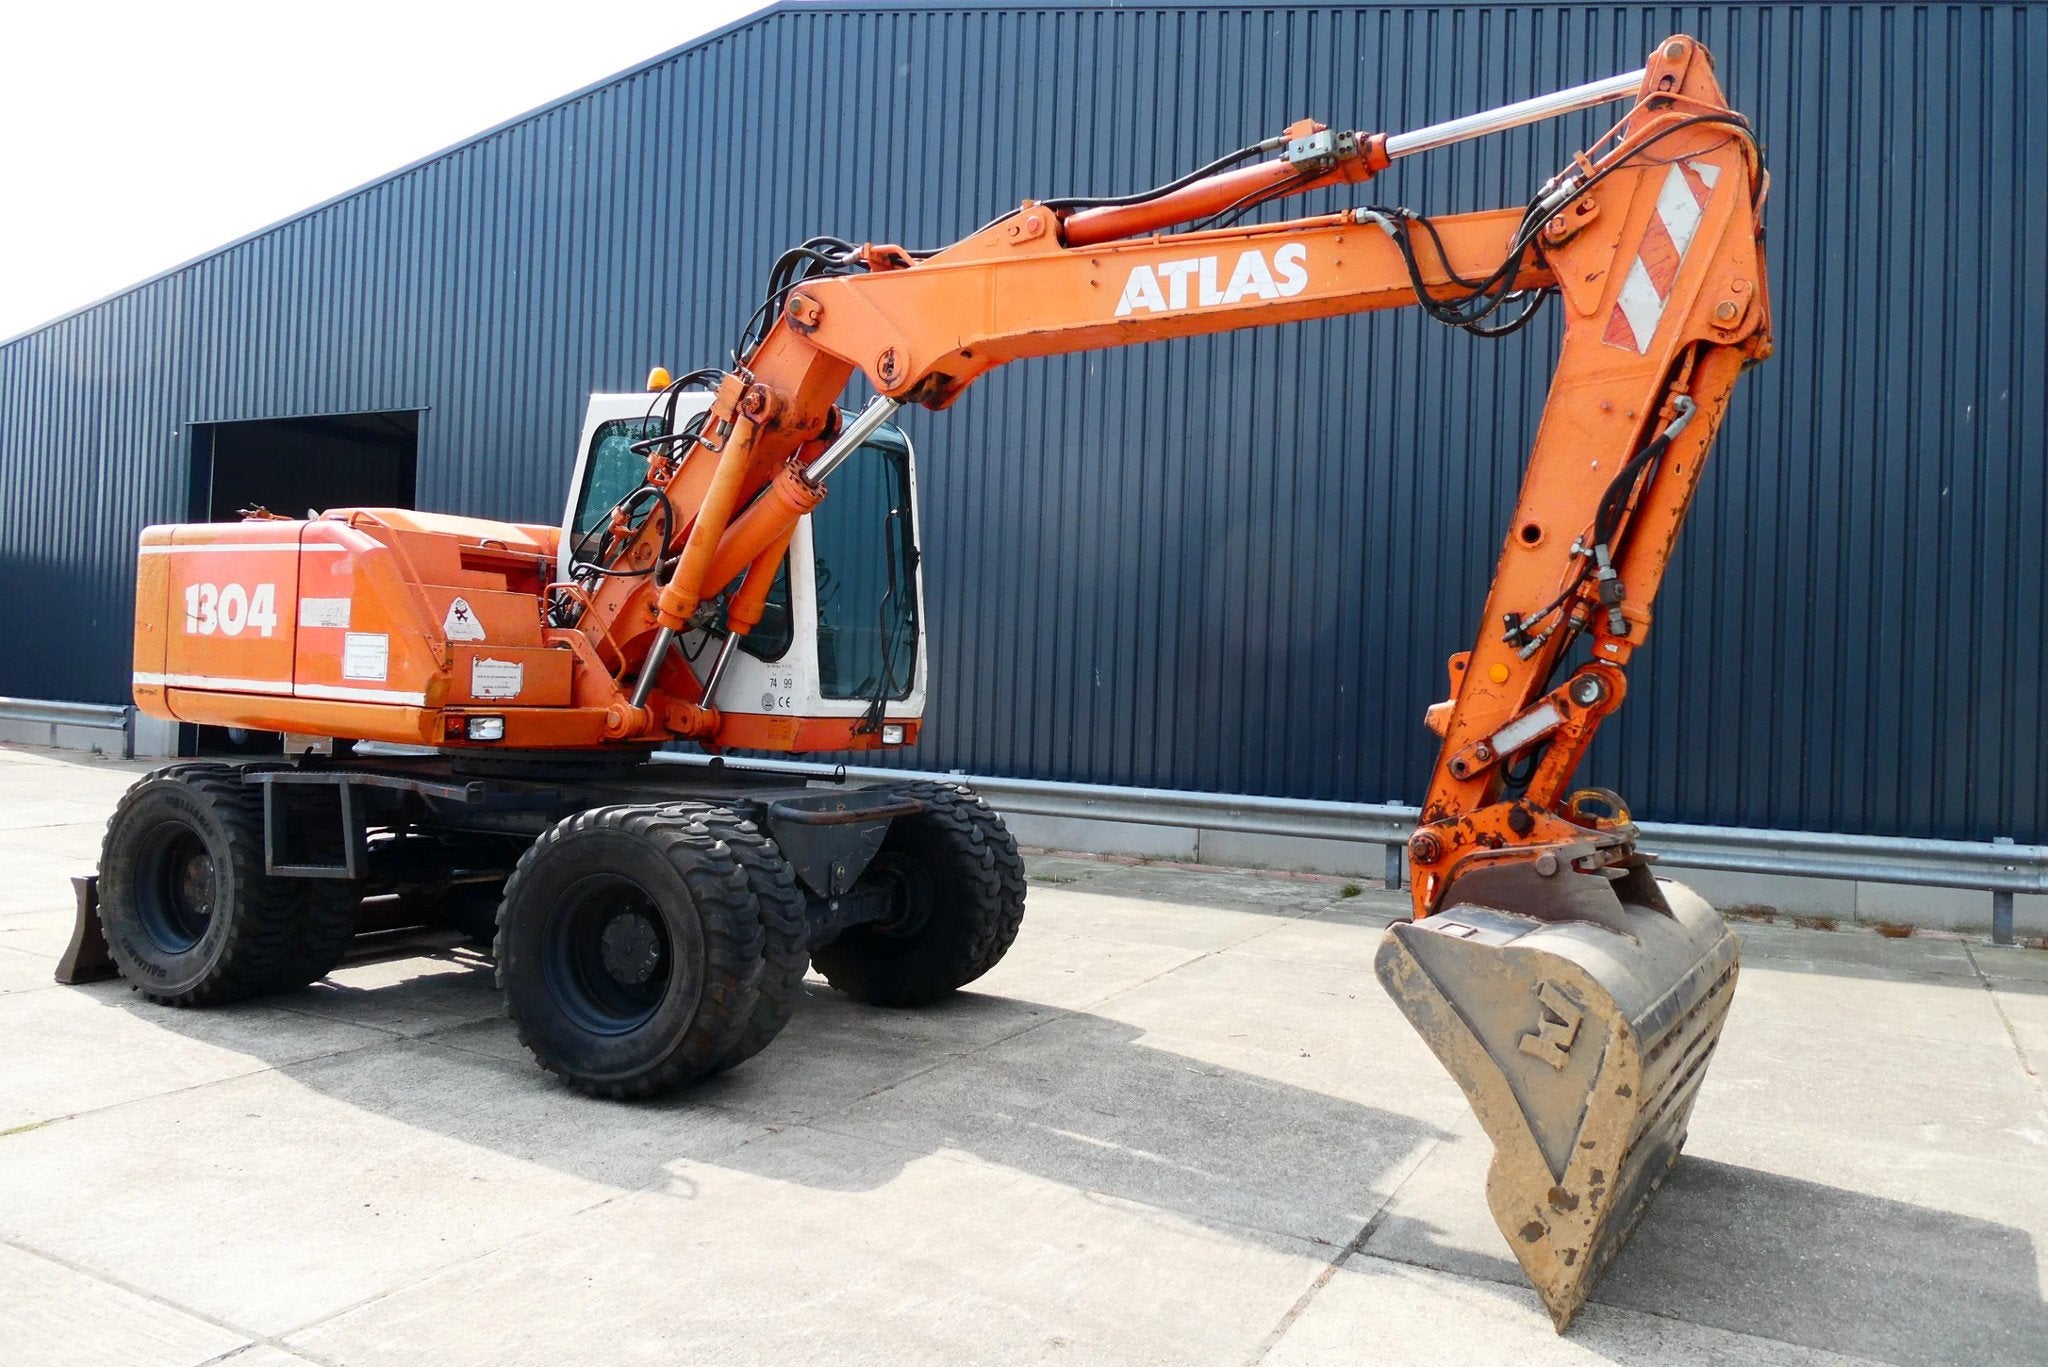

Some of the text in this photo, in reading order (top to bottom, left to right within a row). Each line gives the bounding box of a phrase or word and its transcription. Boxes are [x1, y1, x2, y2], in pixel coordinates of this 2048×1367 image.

[1113, 243, 1308, 317] ATLAS
[185, 582, 277, 637] 1304
[784, 678, 792, 689] 99
[778, 696, 791, 707] CE
